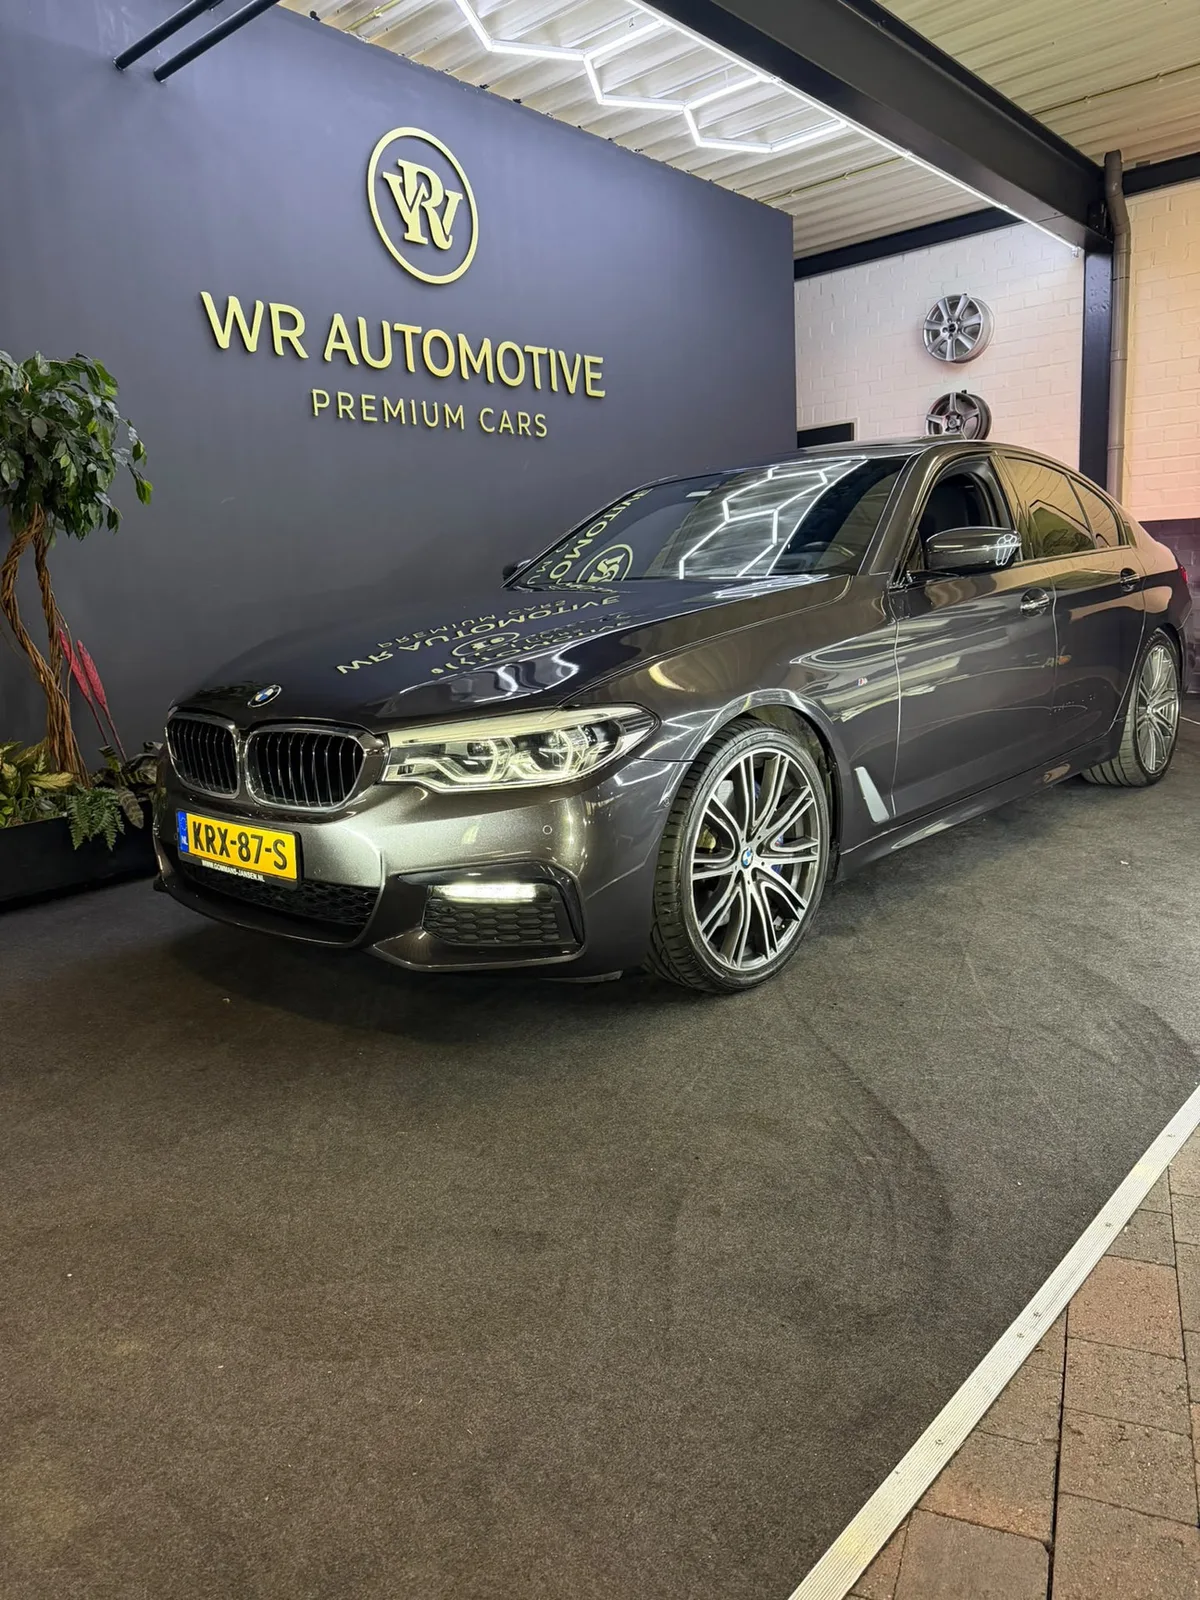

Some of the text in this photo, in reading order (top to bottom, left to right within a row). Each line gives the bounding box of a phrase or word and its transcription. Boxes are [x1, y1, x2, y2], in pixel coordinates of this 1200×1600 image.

[200, 291, 606, 397] WR AUTOMOTIVE
[311, 388, 548, 438] PREMIUM CARS
[193, 821, 288, 870] KRX-87-S
